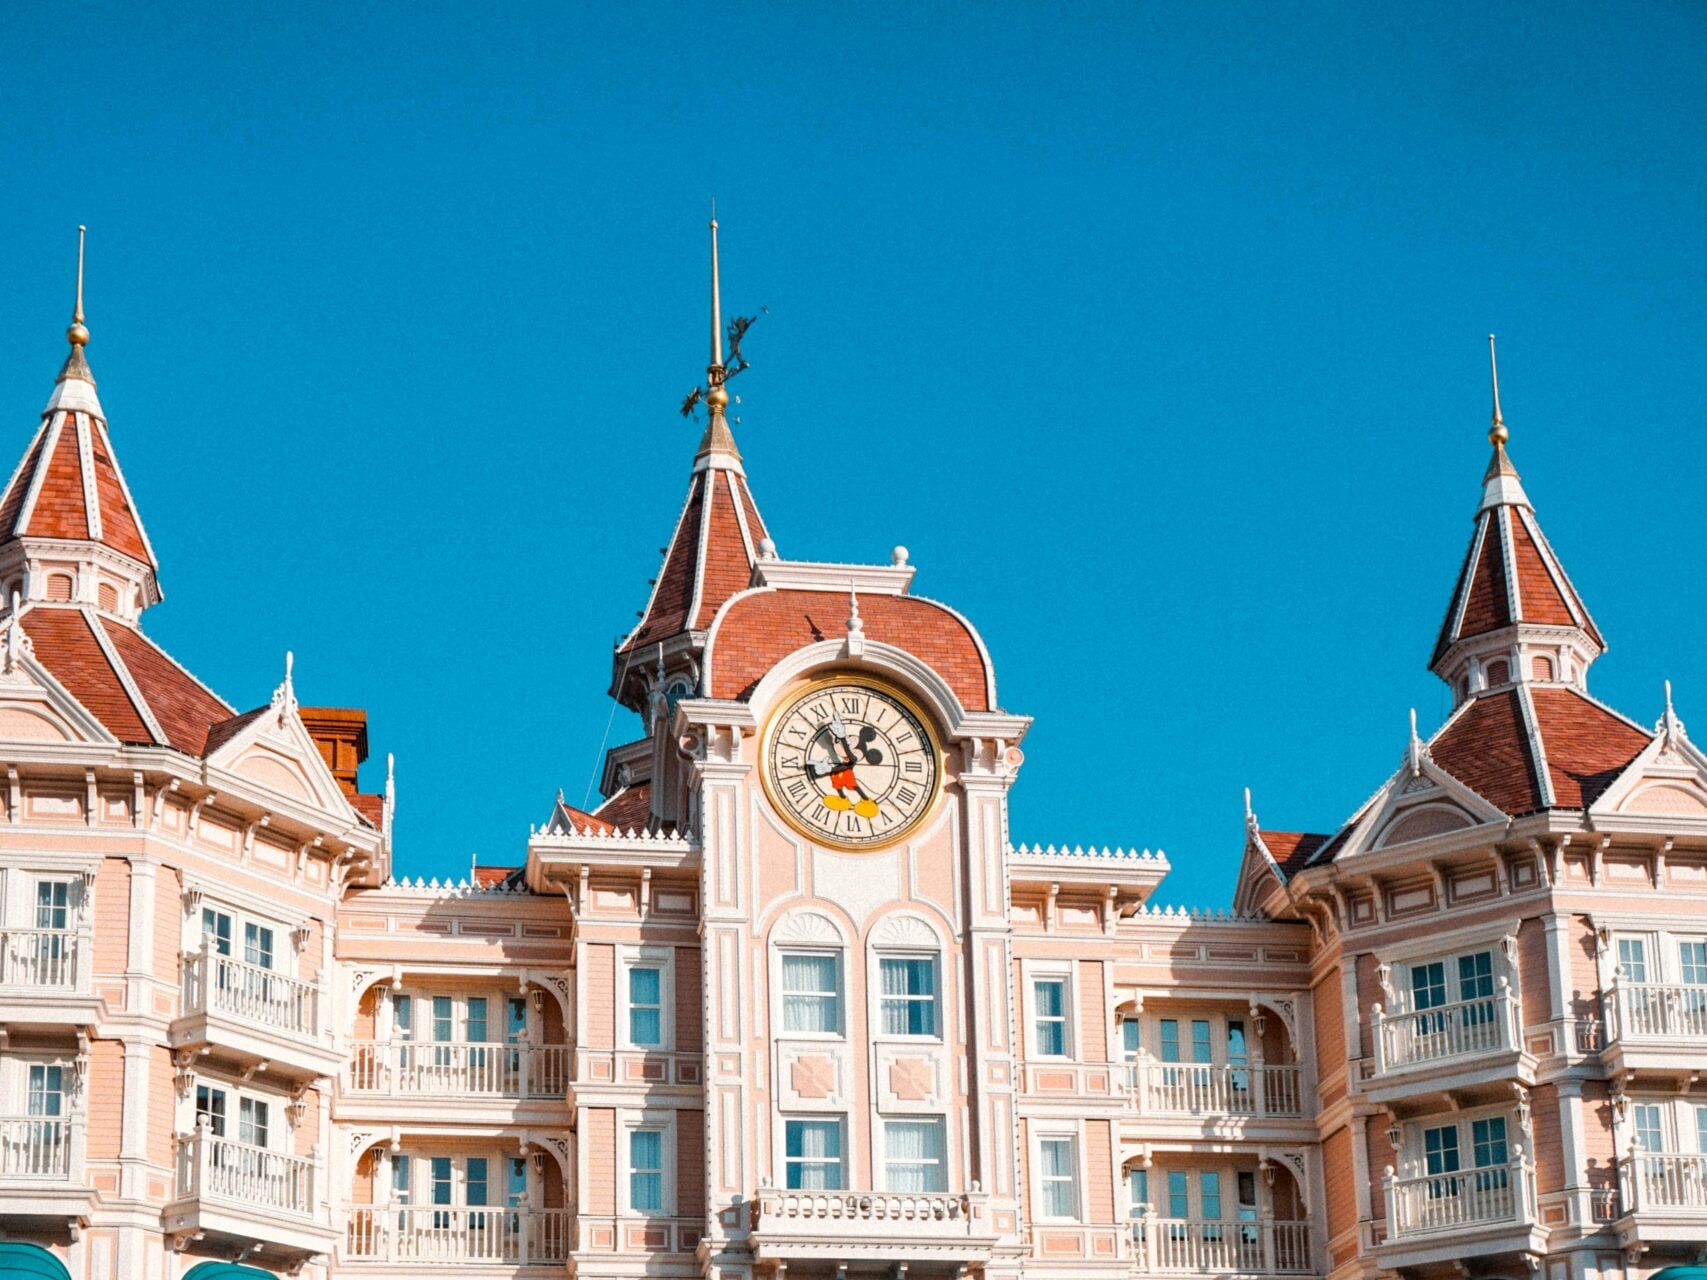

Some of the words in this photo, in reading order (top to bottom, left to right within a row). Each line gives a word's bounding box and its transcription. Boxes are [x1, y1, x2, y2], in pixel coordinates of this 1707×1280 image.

[810, 703, 829, 722] XI
[841, 697, 859, 714] XII
[876, 708, 886, 722] I
[788, 726, 807, 740] X
[896, 731, 913, 744] II
[781, 755, 799, 770] IX
[905, 761, 922, 773] III
[787, 781, 807, 804] VIII
[896, 787, 916, 806] IIII
[811, 805, 830, 826] VII
[880, 810, 893, 826] V
[846, 815, 862, 833] VI
